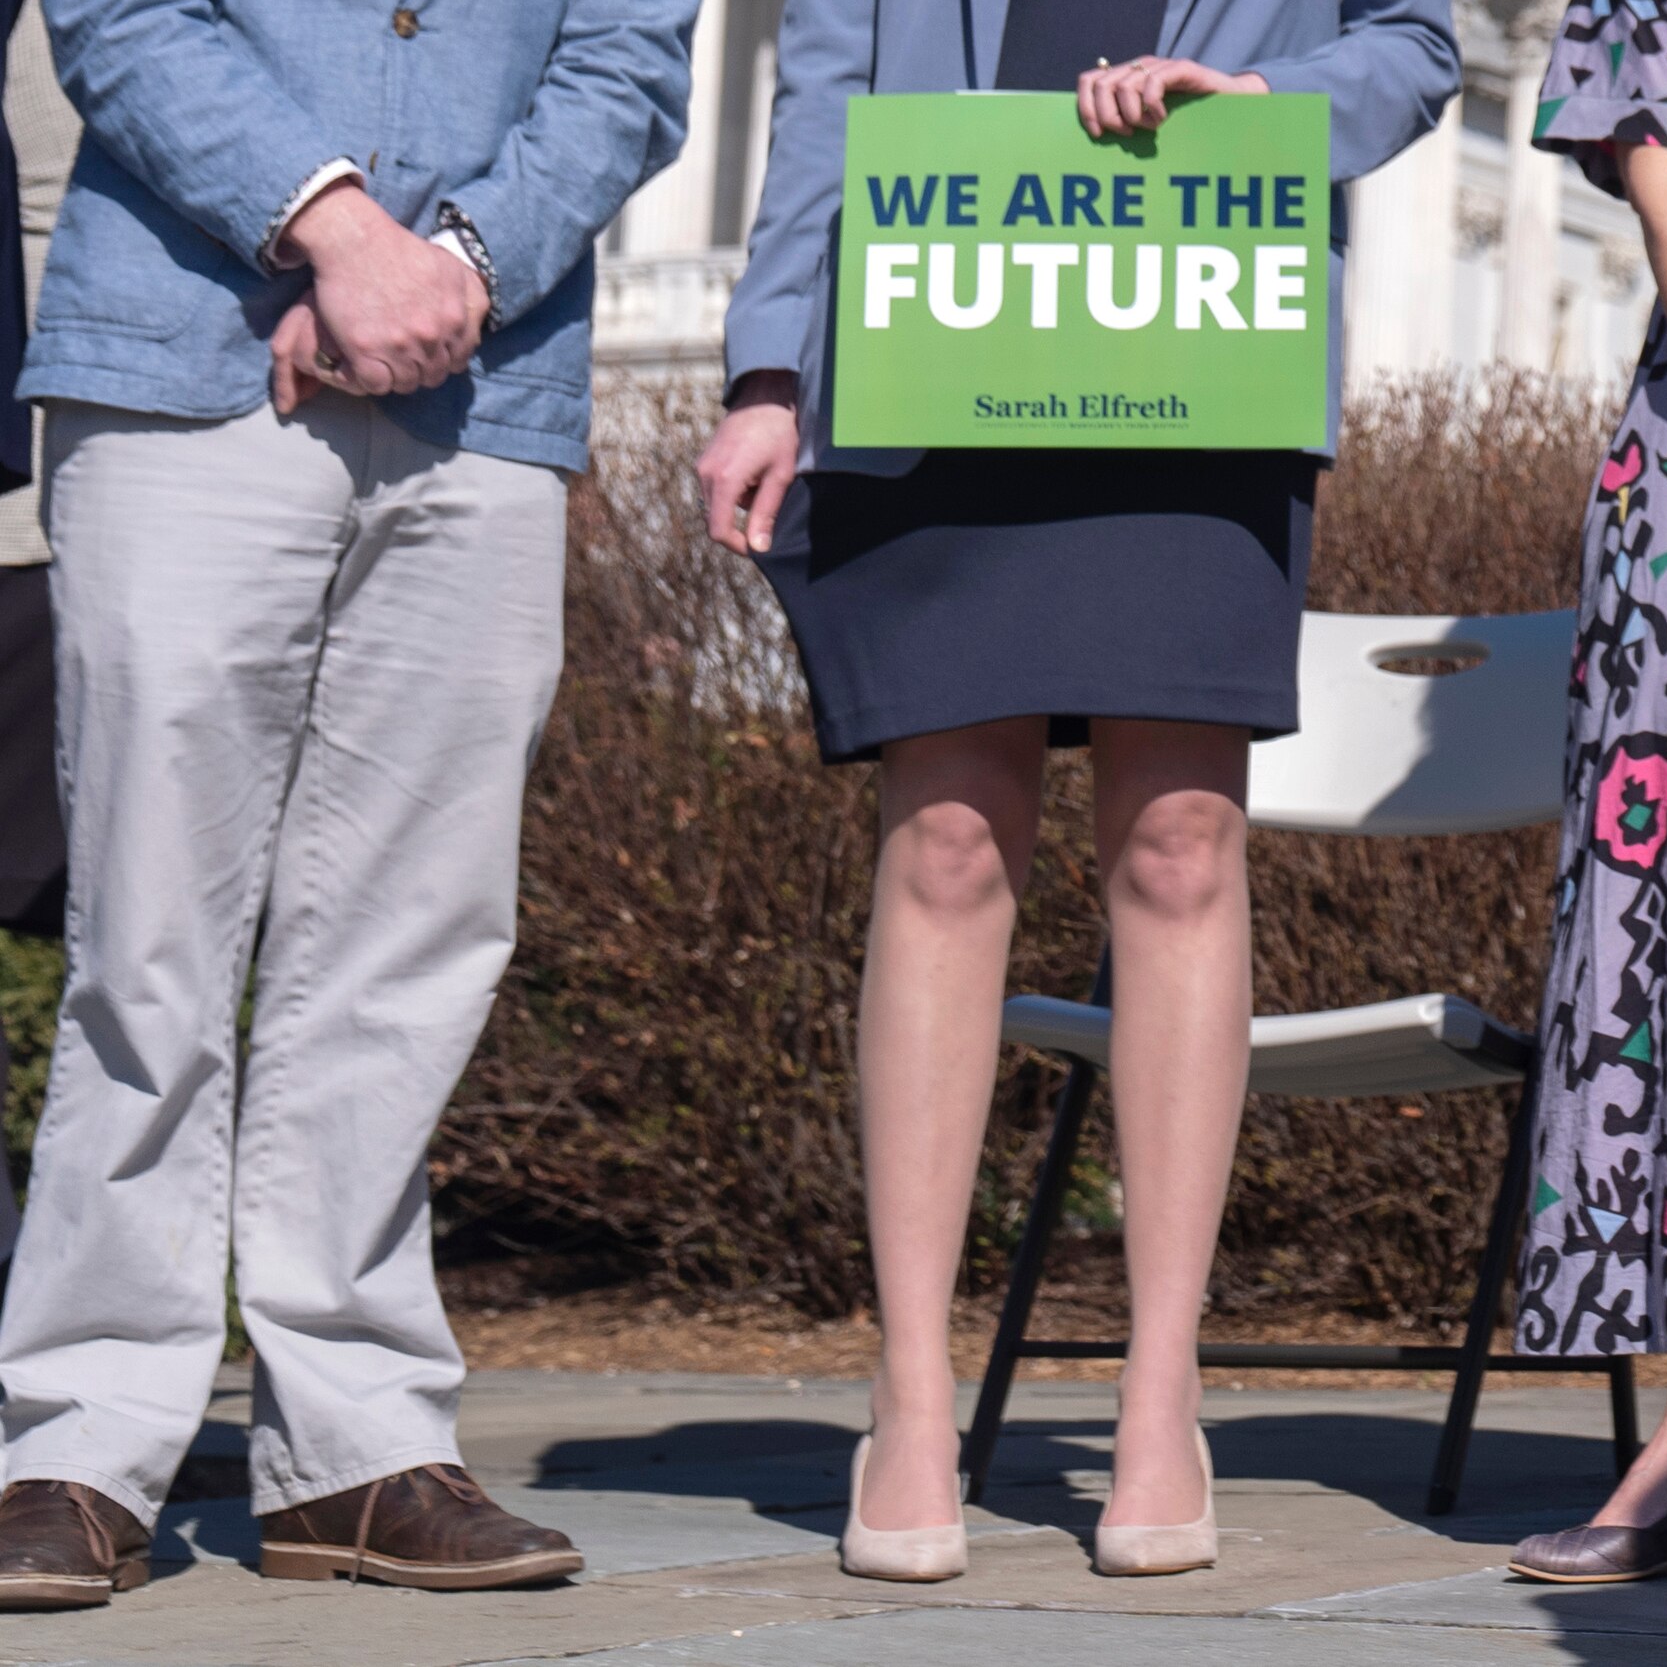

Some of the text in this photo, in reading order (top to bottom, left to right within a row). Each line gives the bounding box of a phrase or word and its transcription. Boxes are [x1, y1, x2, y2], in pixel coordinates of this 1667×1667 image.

[866, 173, 1306, 229] WE ARE THE
[863, 242, 1308, 330] FUTURE
[973, 393, 1189, 419] Sarah Elfreth
